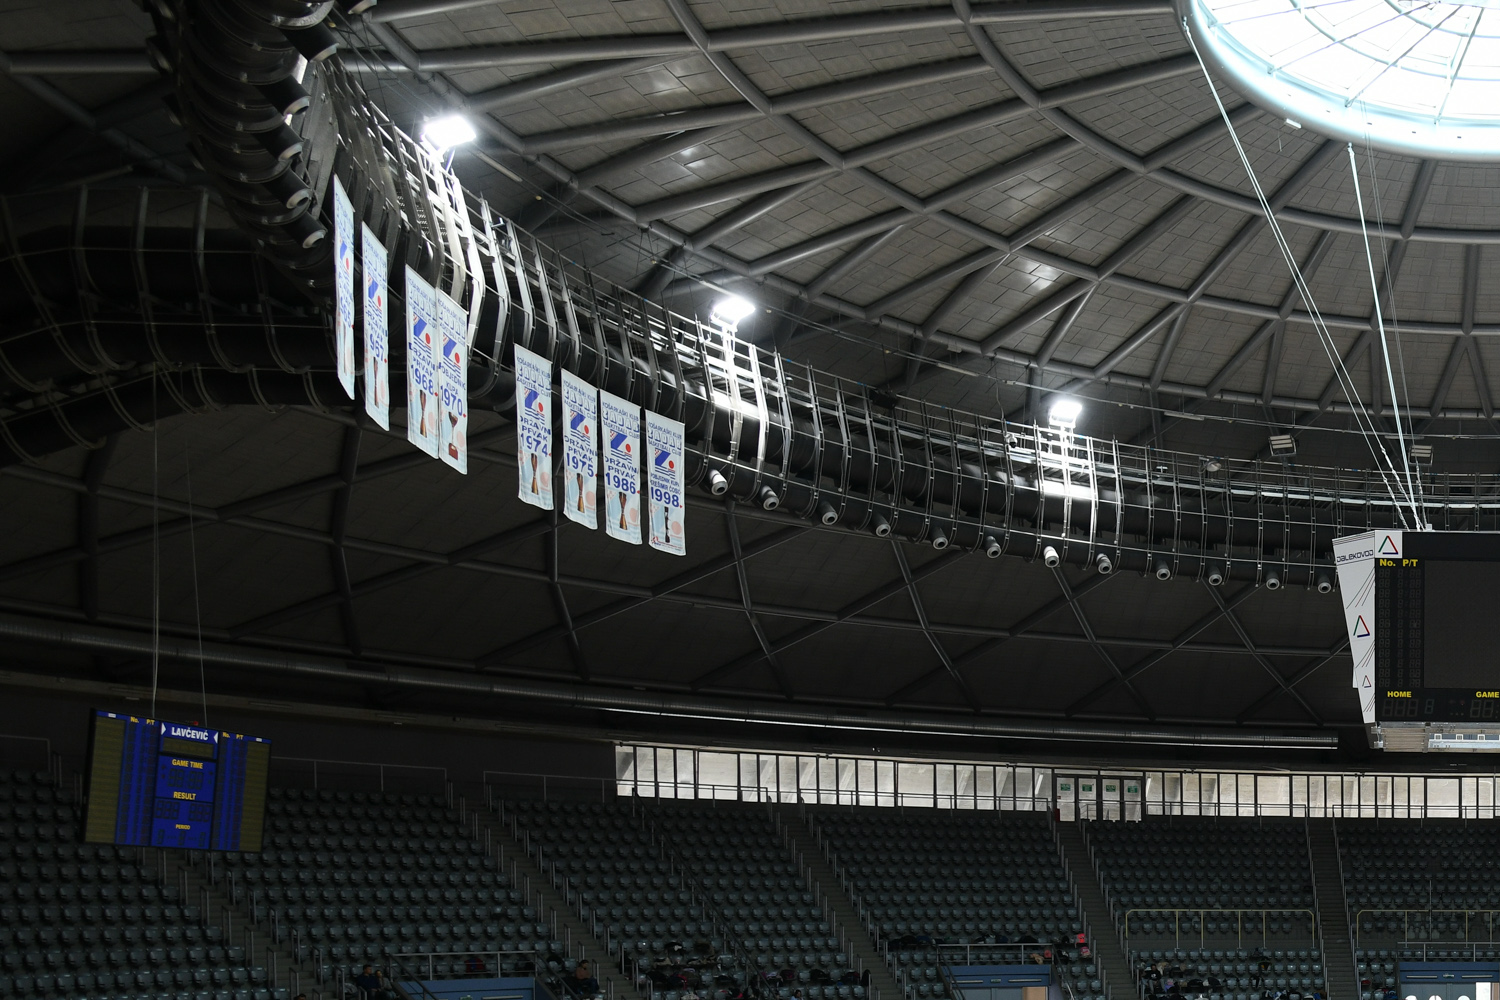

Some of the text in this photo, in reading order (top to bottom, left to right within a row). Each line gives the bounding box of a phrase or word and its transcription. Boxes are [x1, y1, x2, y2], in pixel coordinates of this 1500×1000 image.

[1379, 558, 1418, 567] No. P/T
[1387, 690, 1412, 698] HOME
[171, 726, 209, 741] LAVČEVIĆ
[172, 758, 203, 769] GAME TIME
[173, 791, 196, 801] RESULT
